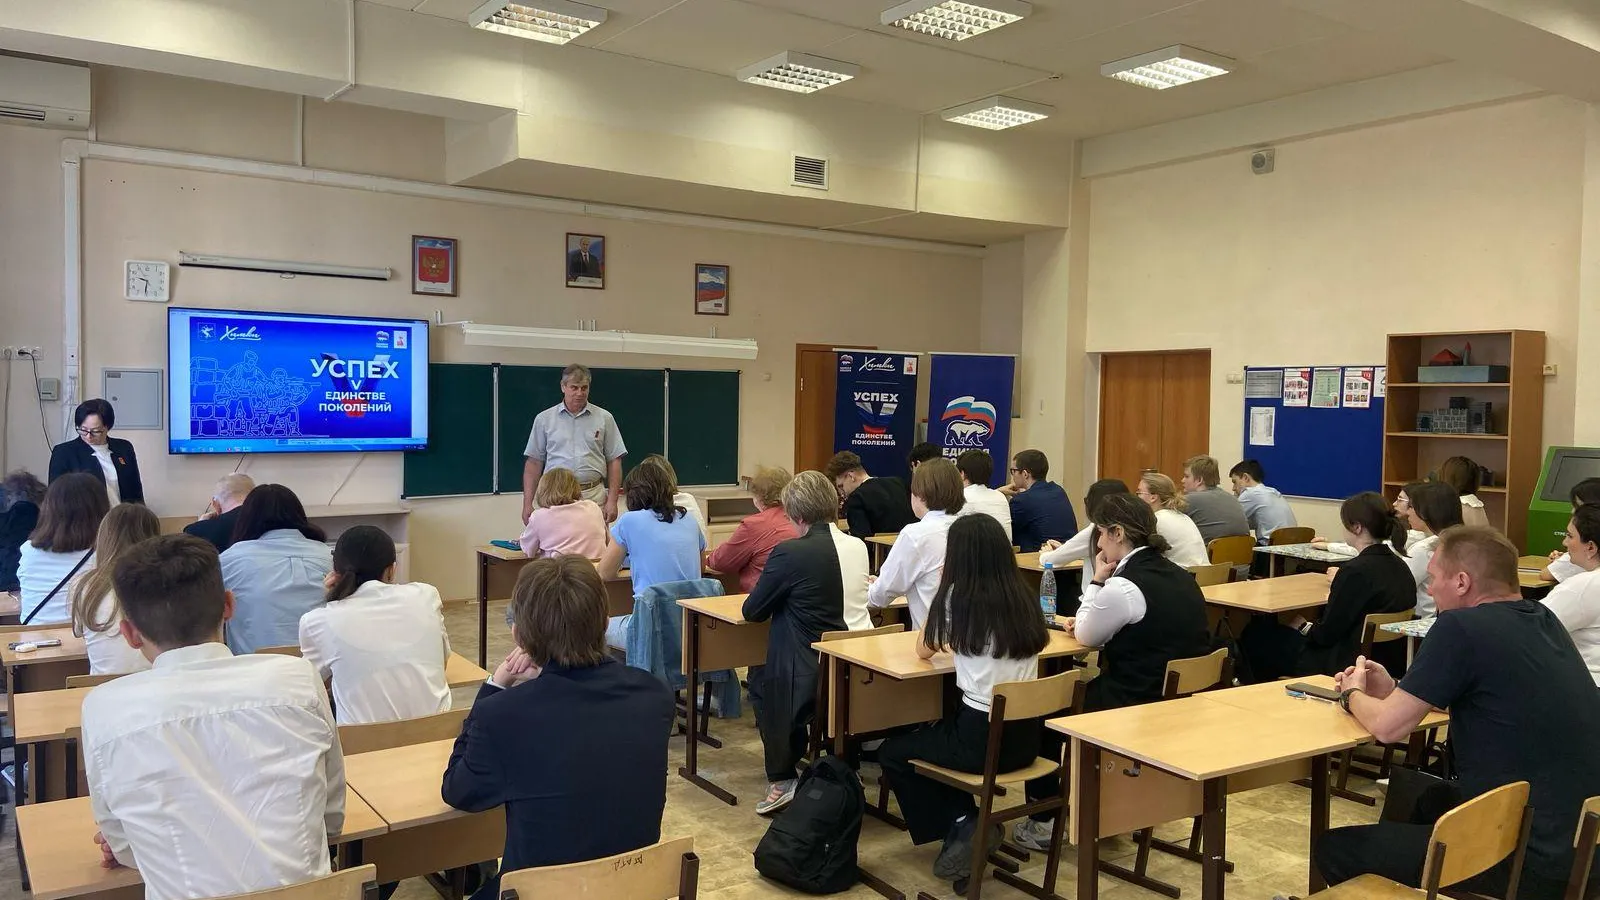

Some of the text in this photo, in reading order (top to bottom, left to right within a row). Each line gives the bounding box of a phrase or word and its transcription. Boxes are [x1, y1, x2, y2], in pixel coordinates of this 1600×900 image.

[310, 358, 399, 379] УСПЕХ
[325, 391, 386, 401] ЕДИНСТВЕ
[853, 391, 899, 403] УСПЕХ
[319, 402, 392, 412] ПОКОЛЕНИЙ
[942, 447, 990, 457] ЕДИЯ
